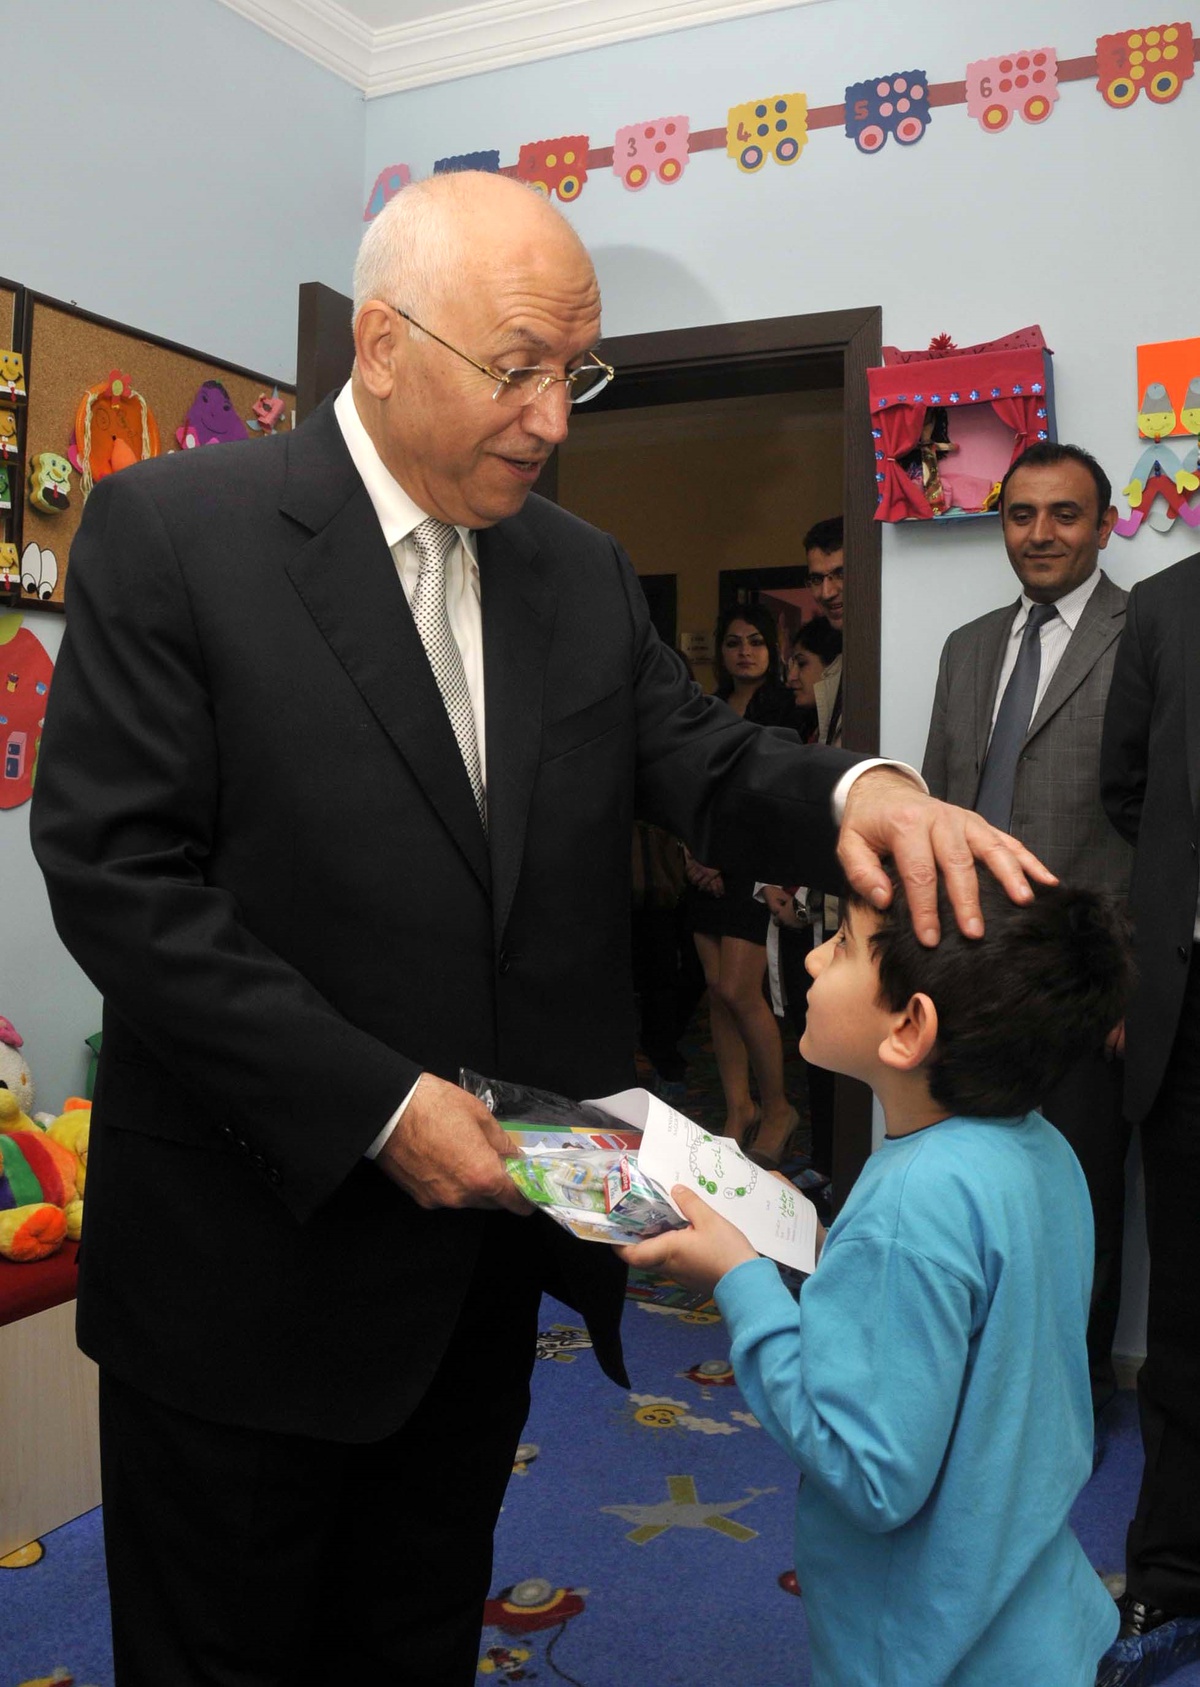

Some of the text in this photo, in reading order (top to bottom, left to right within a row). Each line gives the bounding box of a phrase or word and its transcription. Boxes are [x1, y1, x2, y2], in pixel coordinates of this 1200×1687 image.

[979, 76, 993, 98] 6
[853, 100, 869, 120] 5
[736, 121, 752, 143] 4
[626, 137, 638, 158] 3
